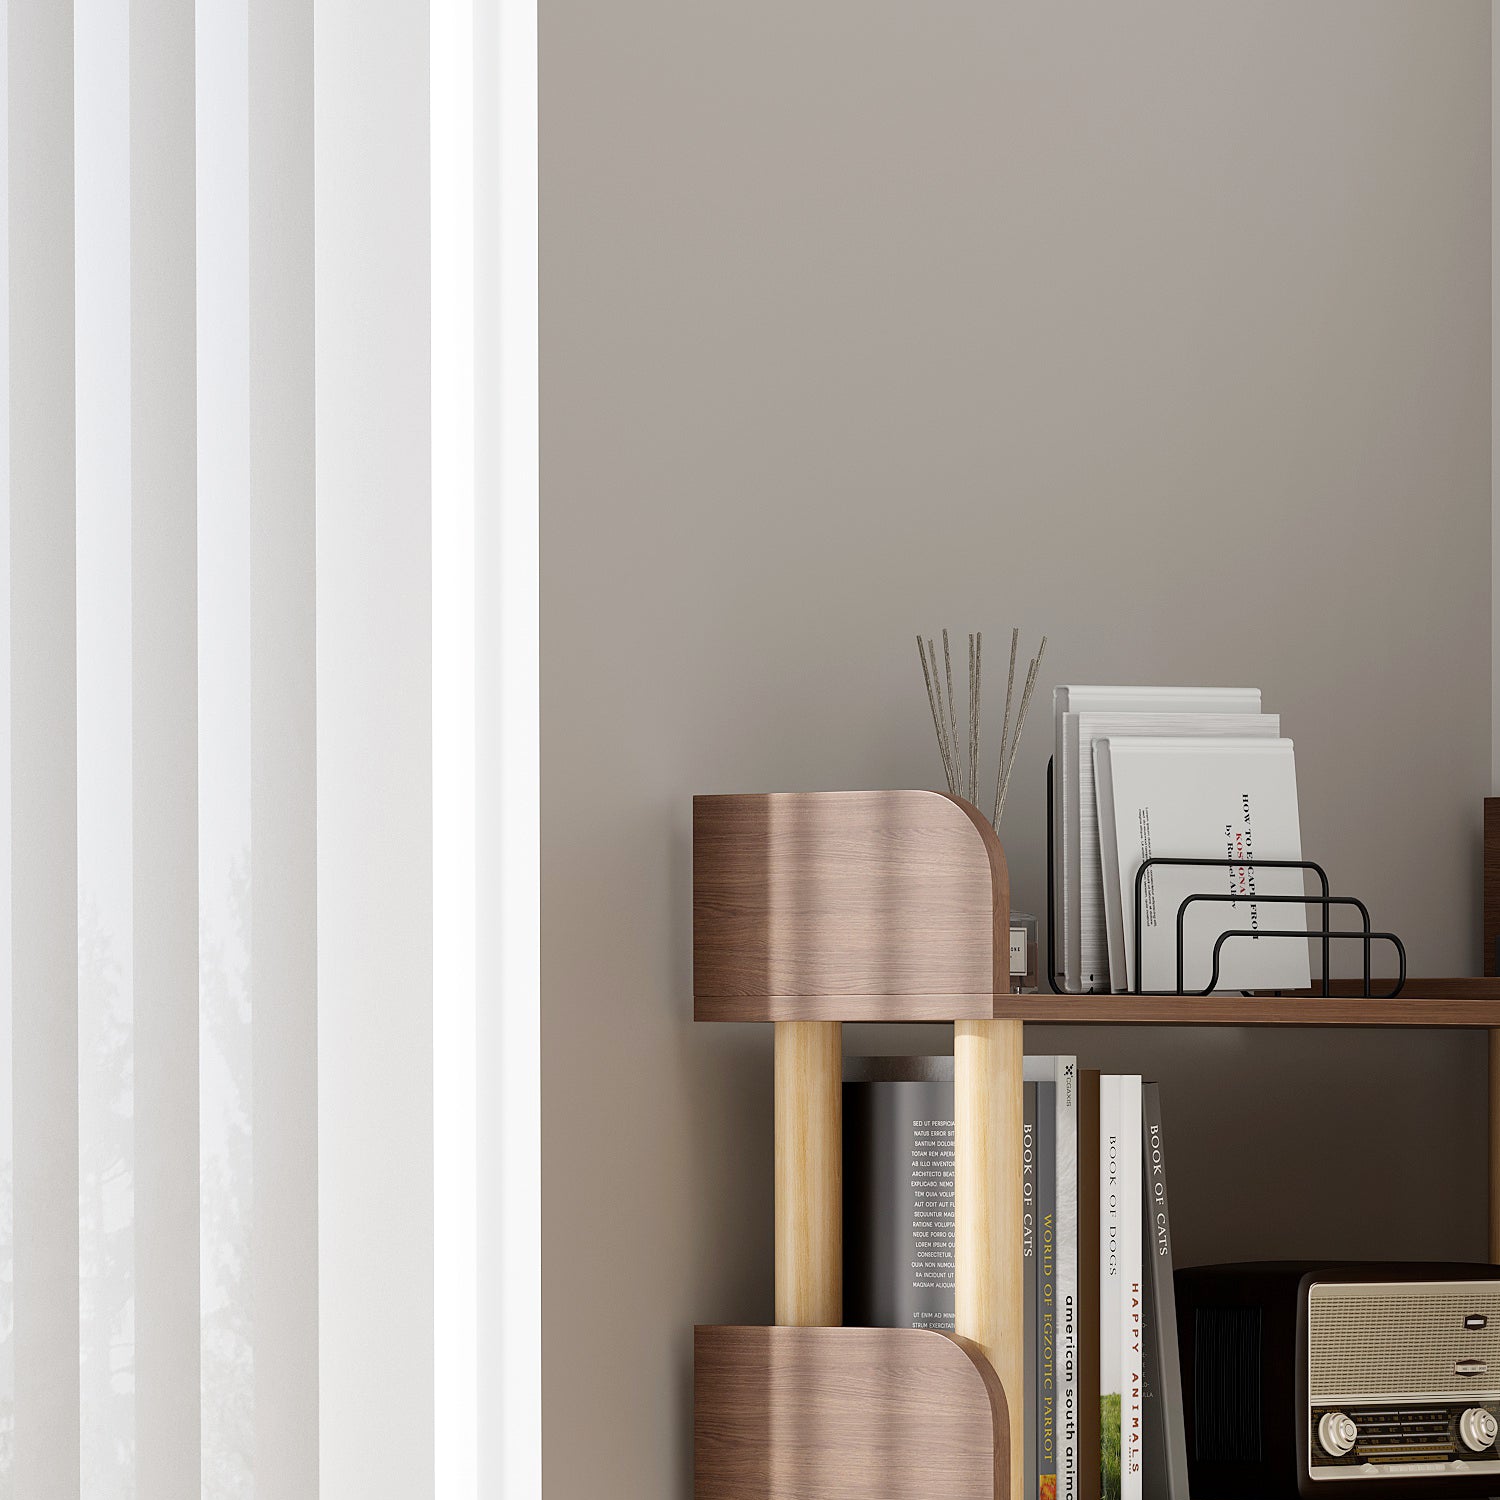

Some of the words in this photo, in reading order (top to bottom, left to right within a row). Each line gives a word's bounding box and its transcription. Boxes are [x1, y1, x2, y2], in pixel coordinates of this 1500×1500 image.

[1225, 825, 1232, 838] by
[1242, 793, 1251, 825] HOW
[1245, 829, 1252, 846] TO
[1247, 851, 1256, 896] ECAP
[1023, 1123, 1032, 1174] BOOK
[1109, 1135, 1117, 1186] BOOK
[1150, 1124, 1161, 1176] BOOK
[1023, 1182, 1032, 1206] OF
[1109, 1194, 1117, 1220] OF
[1154, 1182, 1165, 1206] OF
[1023, 1213, 1032, 1257] CATS
[1044, 1213, 1052, 1276] WORLD
[1109, 1226, 1118, 1277] DOGS
[1156, 1213, 1168, 1256] CATS
[1044, 1283, 1053, 1307] OF
[1044, 1313, 1053, 1390] EGZOTIC
[1065, 1295, 1075, 1382] american
[1044, 1397, 1053, 1463] PARROT
[1065, 1389, 1075, 1440] south
[1132, 1372, 1140, 1473] ANIMALS
